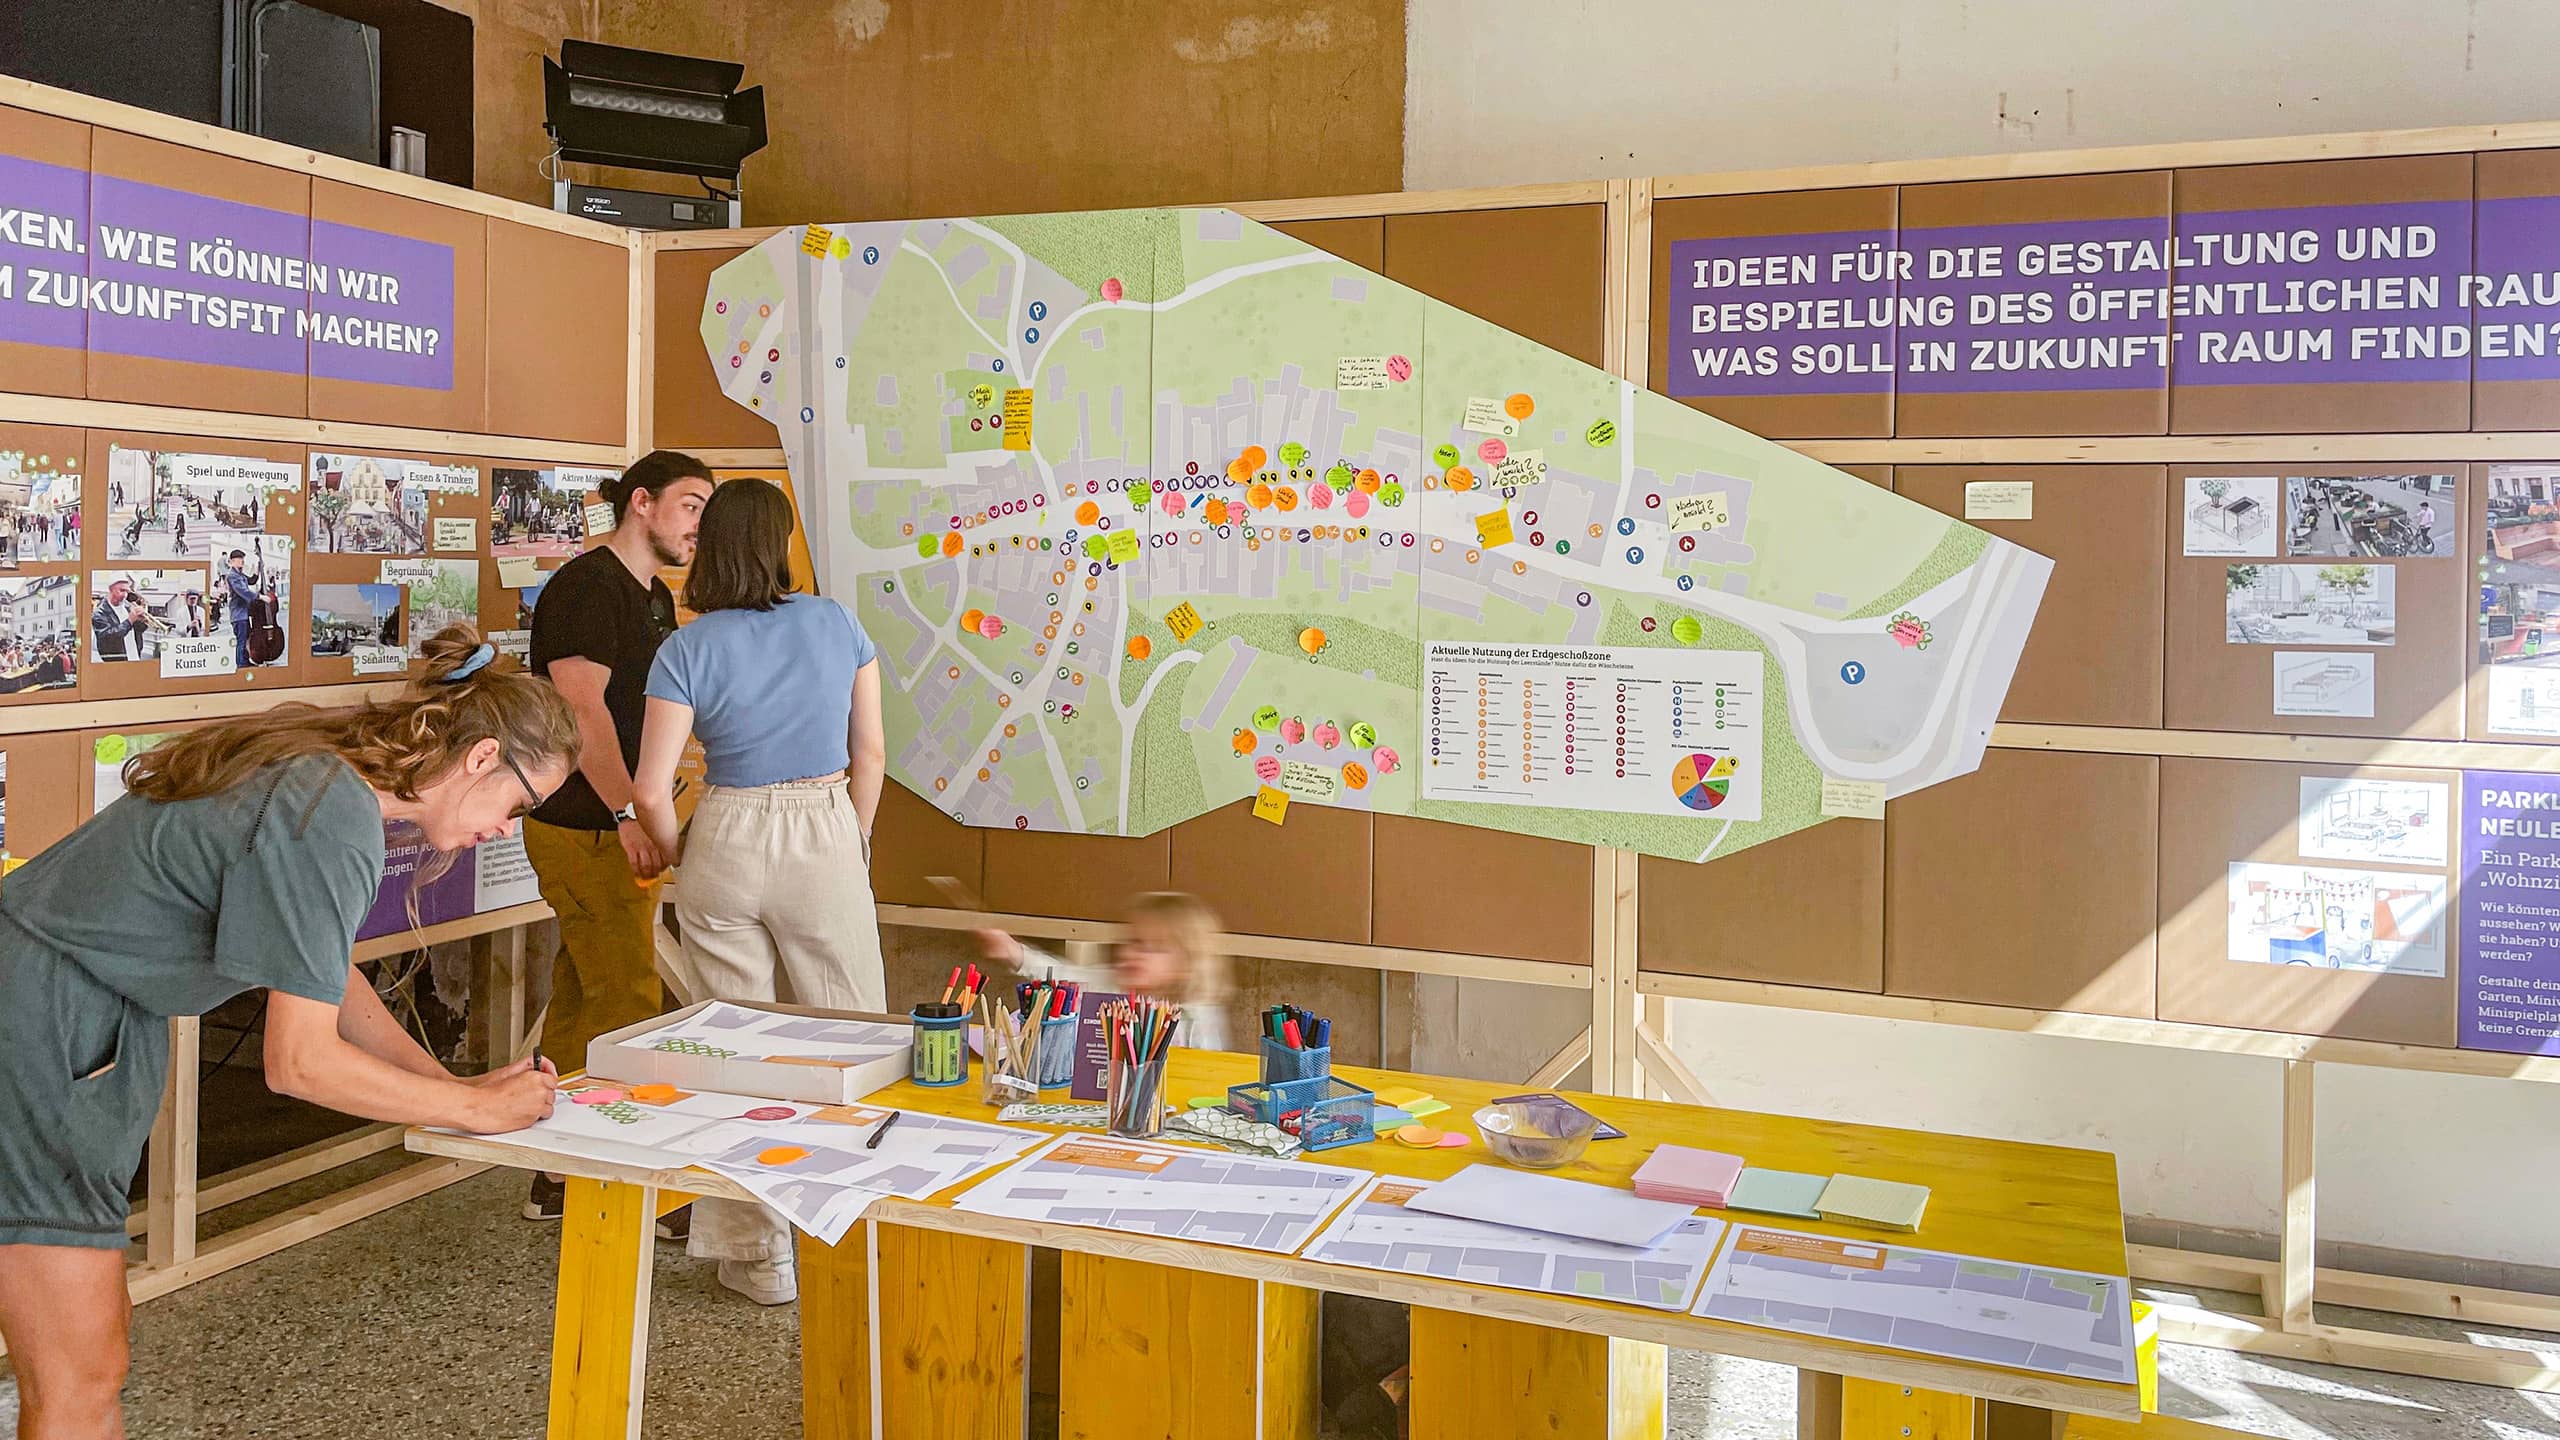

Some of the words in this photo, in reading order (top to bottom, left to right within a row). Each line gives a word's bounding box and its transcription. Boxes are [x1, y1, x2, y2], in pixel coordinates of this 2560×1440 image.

[1693, 254, 1816, 288] IDEEN
[1831, 243, 1913, 283] FÜR
[1928, 246, 2003, 279] DIE
[2018, 230, 2320, 276] GESTALTUNG
[2336, 225, 2436, 261] UND
[100, 225, 177, 269] WIE
[189, 238, 328, 294] KÖNNEN
[337, 268, 399, 305] WIR
[1692, 295, 1955, 333] BESPIELUNG
[1969, 291, 2053, 325] DES
[2068, 276, 2439, 322] ÖFFENTLICHEN
[2458, 271, 2560, 308] RAU
[27, 268, 286, 336] ZUKUNFTSFIT
[296, 309, 439, 356] MACHEN?
[1692, 345, 1778, 376] WAS
[1791, 343, 1894, 374] SOLL
[1908, 341, 1956, 372] IN
[1970, 333, 2184, 371] ZUKUNFT
[2199, 328, 2333, 364] RAUM
[2351, 322, 2560, 360] FINDEN?
[186, 465, 212, 478] Spiel
[216, 467, 235, 477] und
[238, 468, 289, 482] Bewegung
[409, 472, 433, 483] Essen
[435, 474, 441, 482] &
[443, 474, 474, 484] Trinken
[561, 473, 584, 482] Aktive
[387, 566, 433, 578] Begrünung
[175, 642, 221, 654] Straßen-
[1431, 646, 1470, 655] Aktuelle
[1472, 647, 1512, 659] Nutzung
[1514, 648, 1530, 657] der
[1532, 649, 1612, 660] Erdgeschoßzone
[175, 658, 207, 669] Kunst
[2481, 789, 2560, 811] PARKL
[2480, 817, 2560, 839] NEULE
[2480, 850, 2513, 866] Ein
[2518, 852, 2560, 868] Park
[2480, 902, 2504, 913] Wie
[2508, 902, 2560, 916] könnten
[2480, 919, 2546, 932] aussehen?
[2480, 934, 2497, 944] sie
[2501, 934, 2546, 947] haben?
[2549, 938, 2560, 948] U
[2480, 949, 2533, 961] werden?
[2479, 975, 2530, 989] Gestalte
[2479, 991, 2524, 1005] Garten,
[2479, 1021, 2513, 1034] keine
[2516, 1025, 2560, 1038] Grenze
